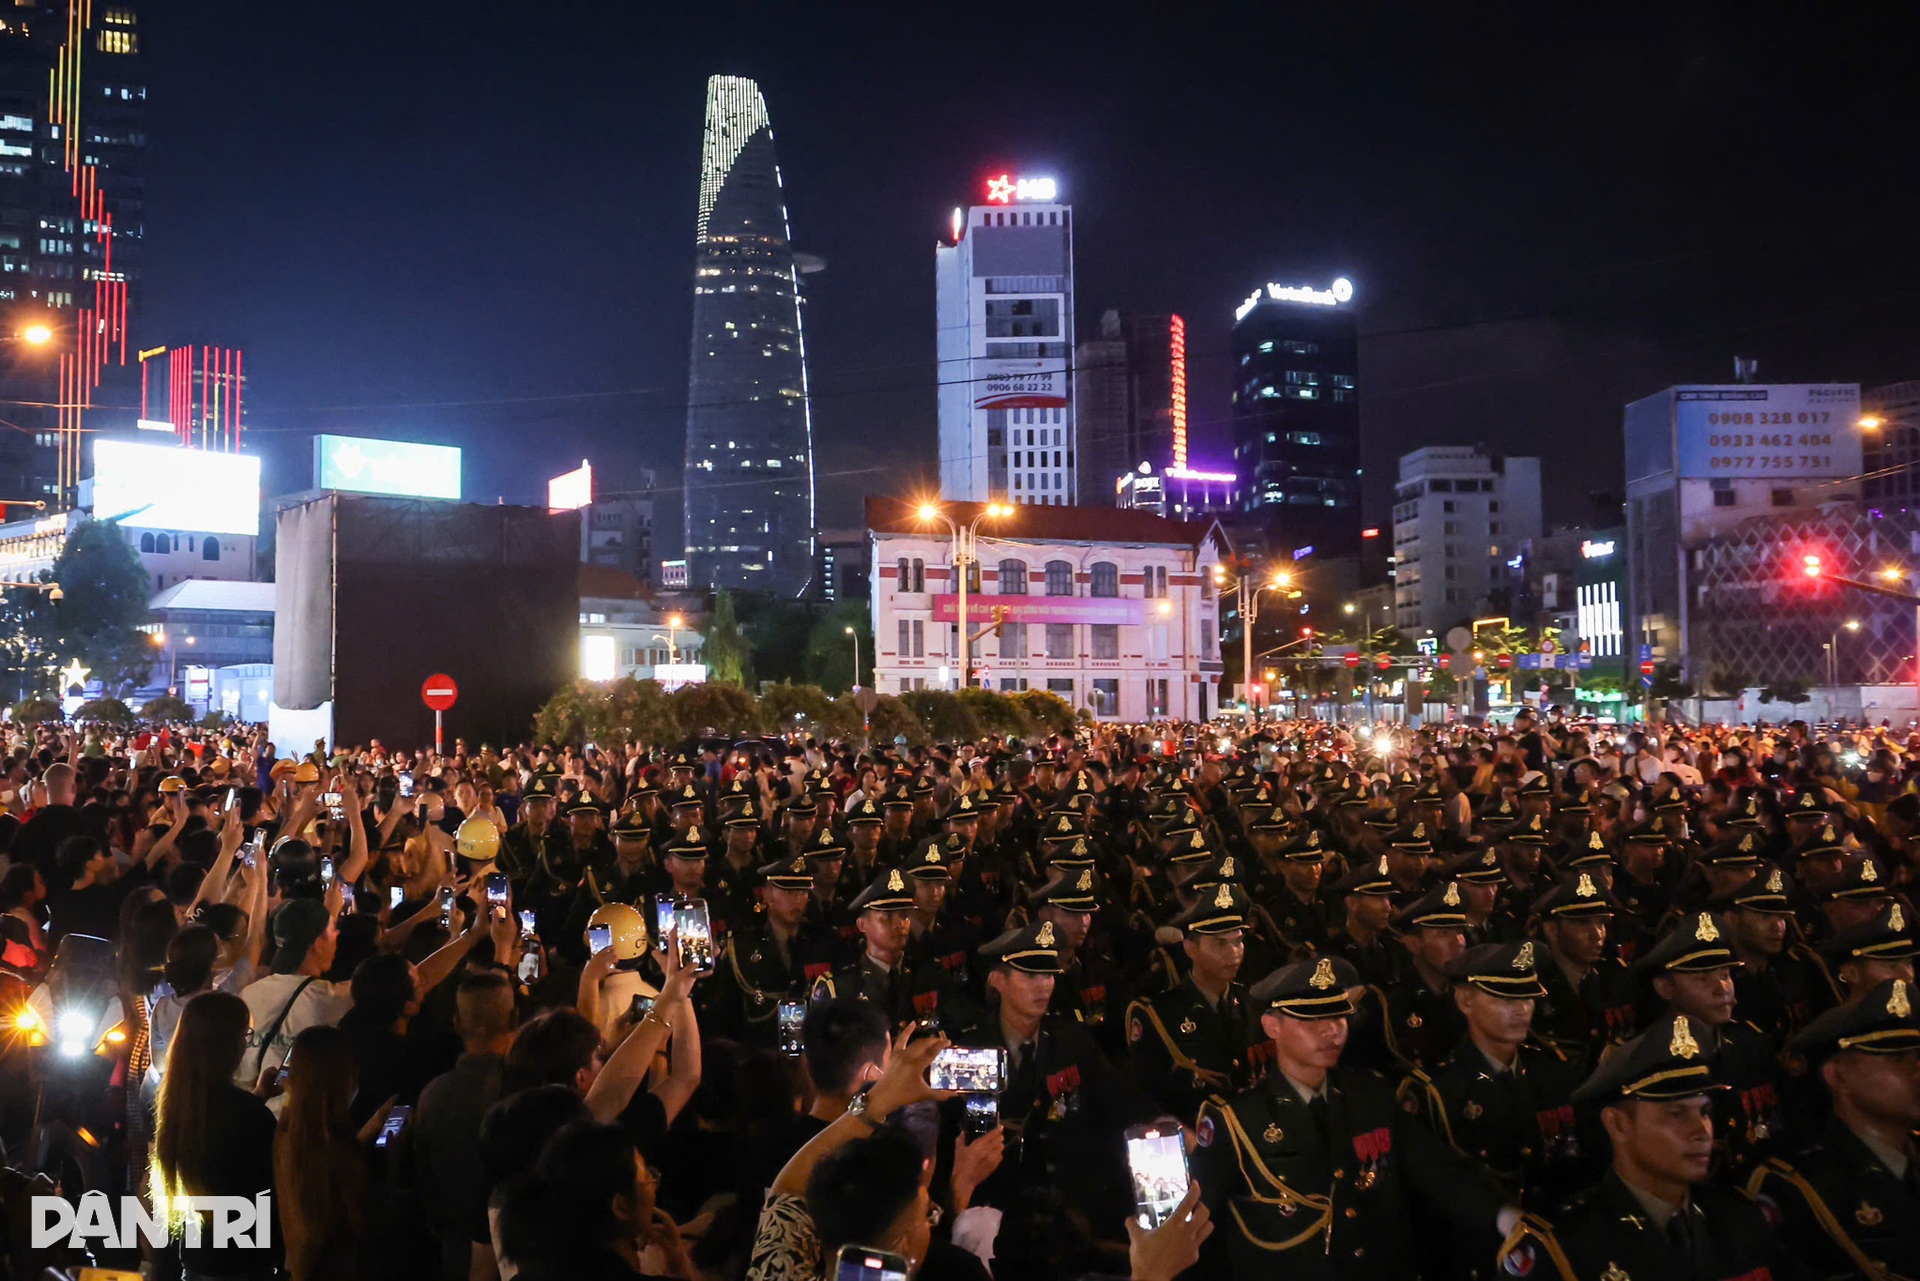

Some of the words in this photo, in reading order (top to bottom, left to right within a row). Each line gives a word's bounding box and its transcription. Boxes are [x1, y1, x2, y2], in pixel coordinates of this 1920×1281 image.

[987, 383, 1010, 391] 0906
[1013, 383, 1025, 391] 68
[1027, 383, 1038, 391] 22
[1041, 383, 1052, 391] 22
[1709, 412, 1754, 425] 0908
[1760, 412, 1793, 425] 328
[1798, 412, 1831, 425] 017
[1709, 434, 1754, 447] 0933
[1760, 434, 1793, 447] 462
[1799, 434, 1832, 447] 404
[1710, 456, 1755, 469] 0977
[1760, 456, 1793, 469] 755
